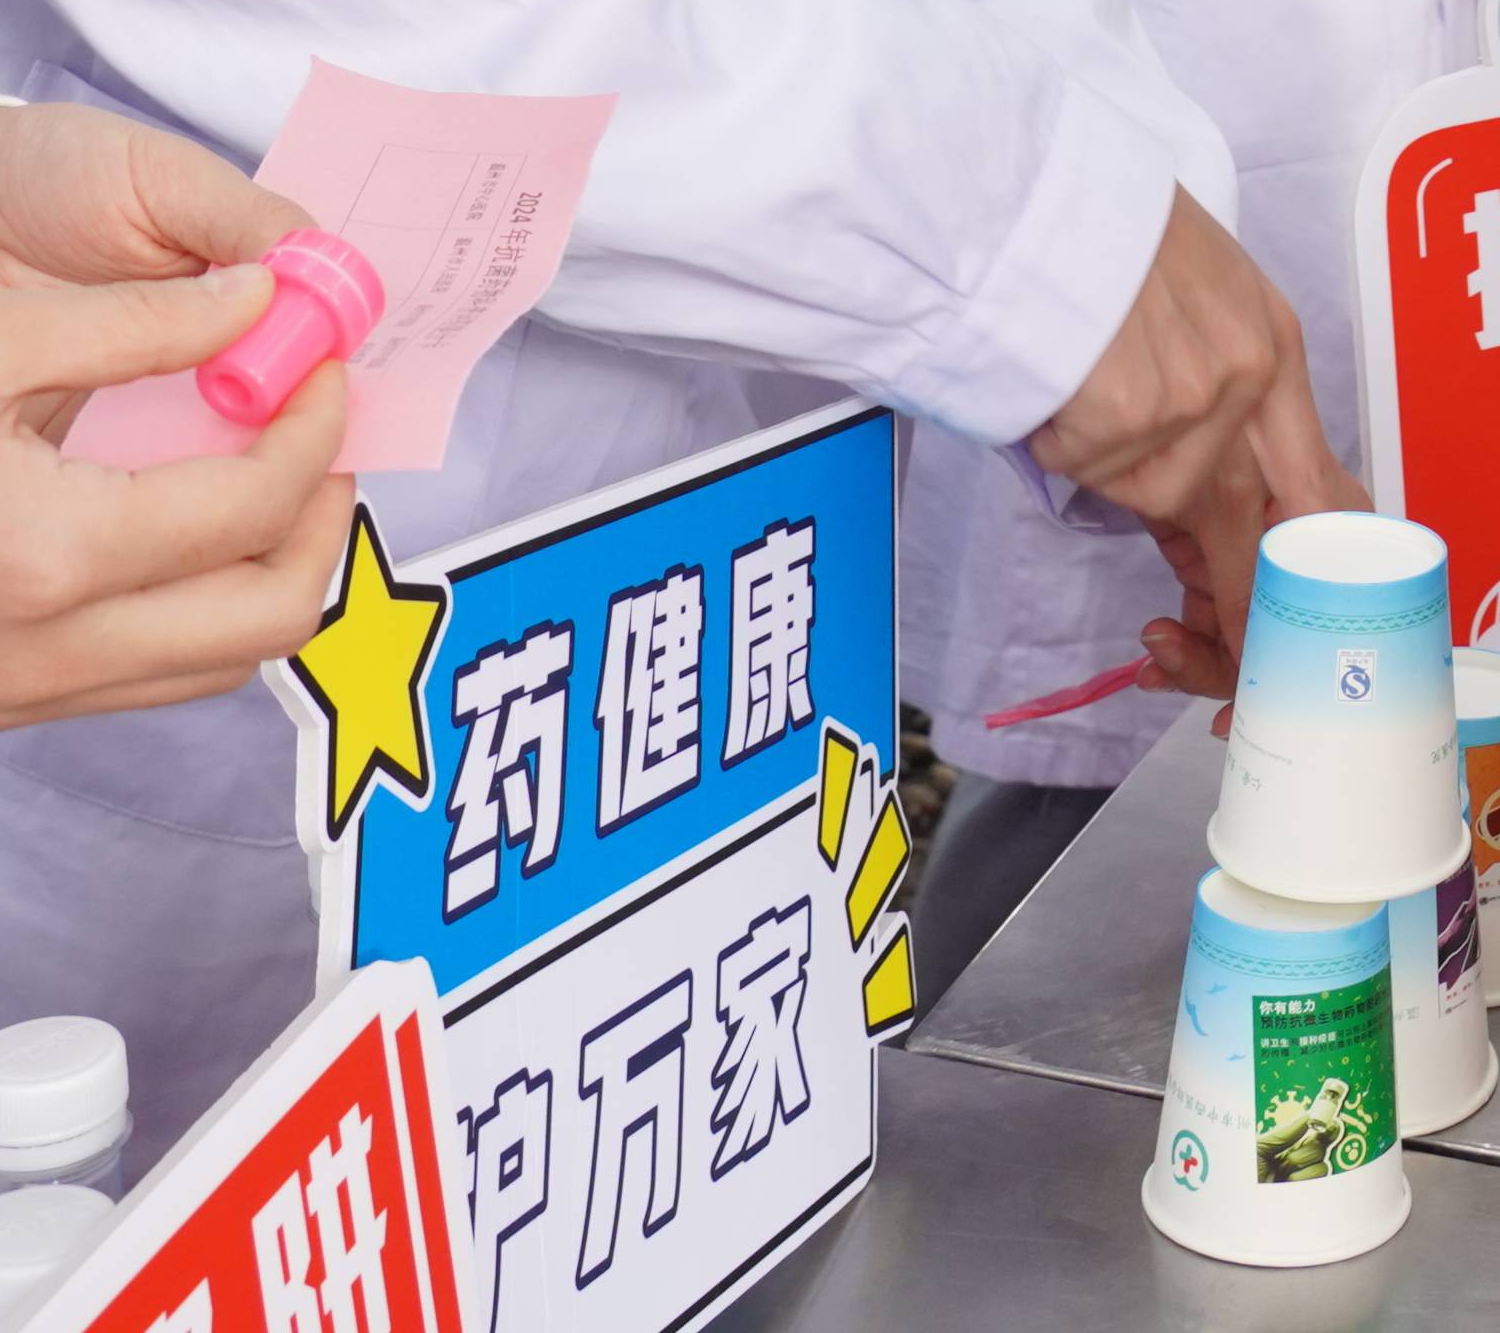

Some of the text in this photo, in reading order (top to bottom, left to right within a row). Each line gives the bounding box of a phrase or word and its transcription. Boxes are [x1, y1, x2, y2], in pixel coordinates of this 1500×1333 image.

[509, 192, 542, 224] 2024
[442, 516, 815, 923] 药健康
[1259, 999, 1315, 1016] 你有能力
